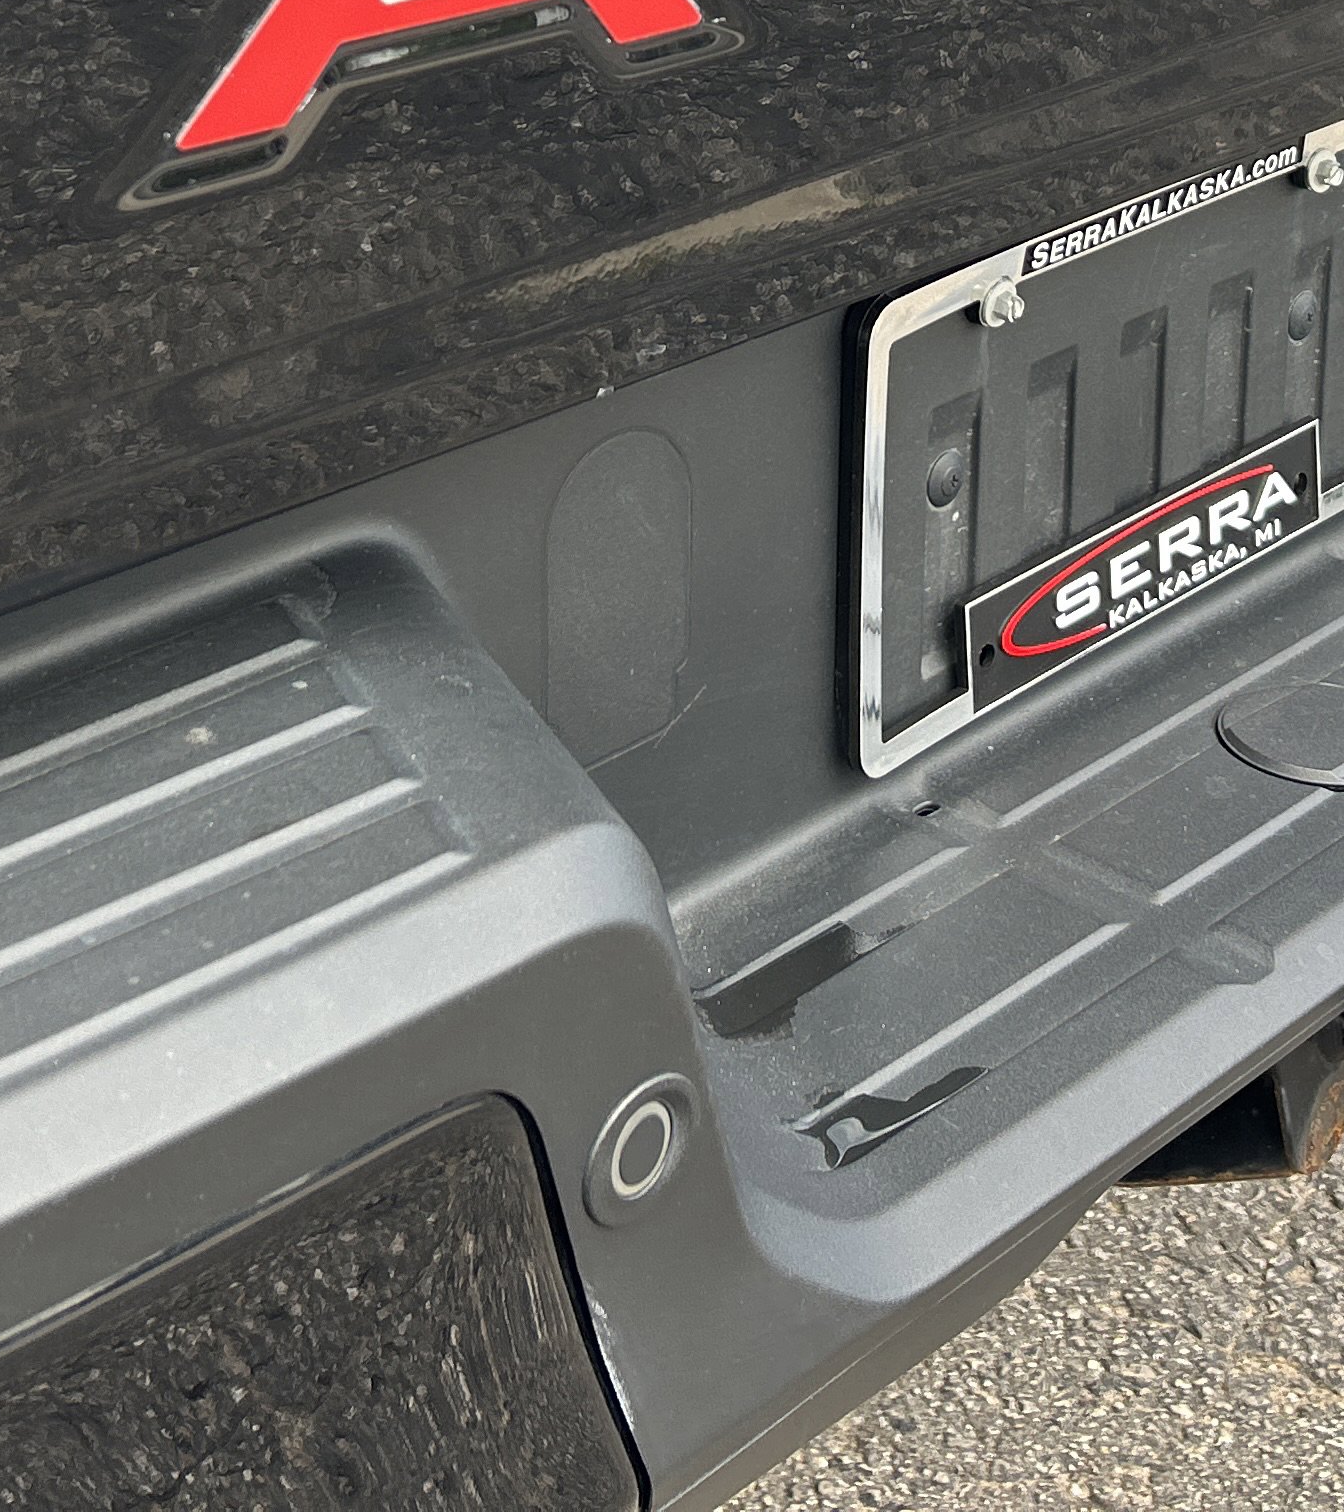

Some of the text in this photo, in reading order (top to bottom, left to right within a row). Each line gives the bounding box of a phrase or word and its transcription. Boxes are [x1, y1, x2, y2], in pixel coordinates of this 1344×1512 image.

[1030, 145, 1298, 271] SERRAKALKASKA.com
[1054, 470, 1299, 630] SERRA
[1108, 517, 1283, 629] KALKASKA, MI
